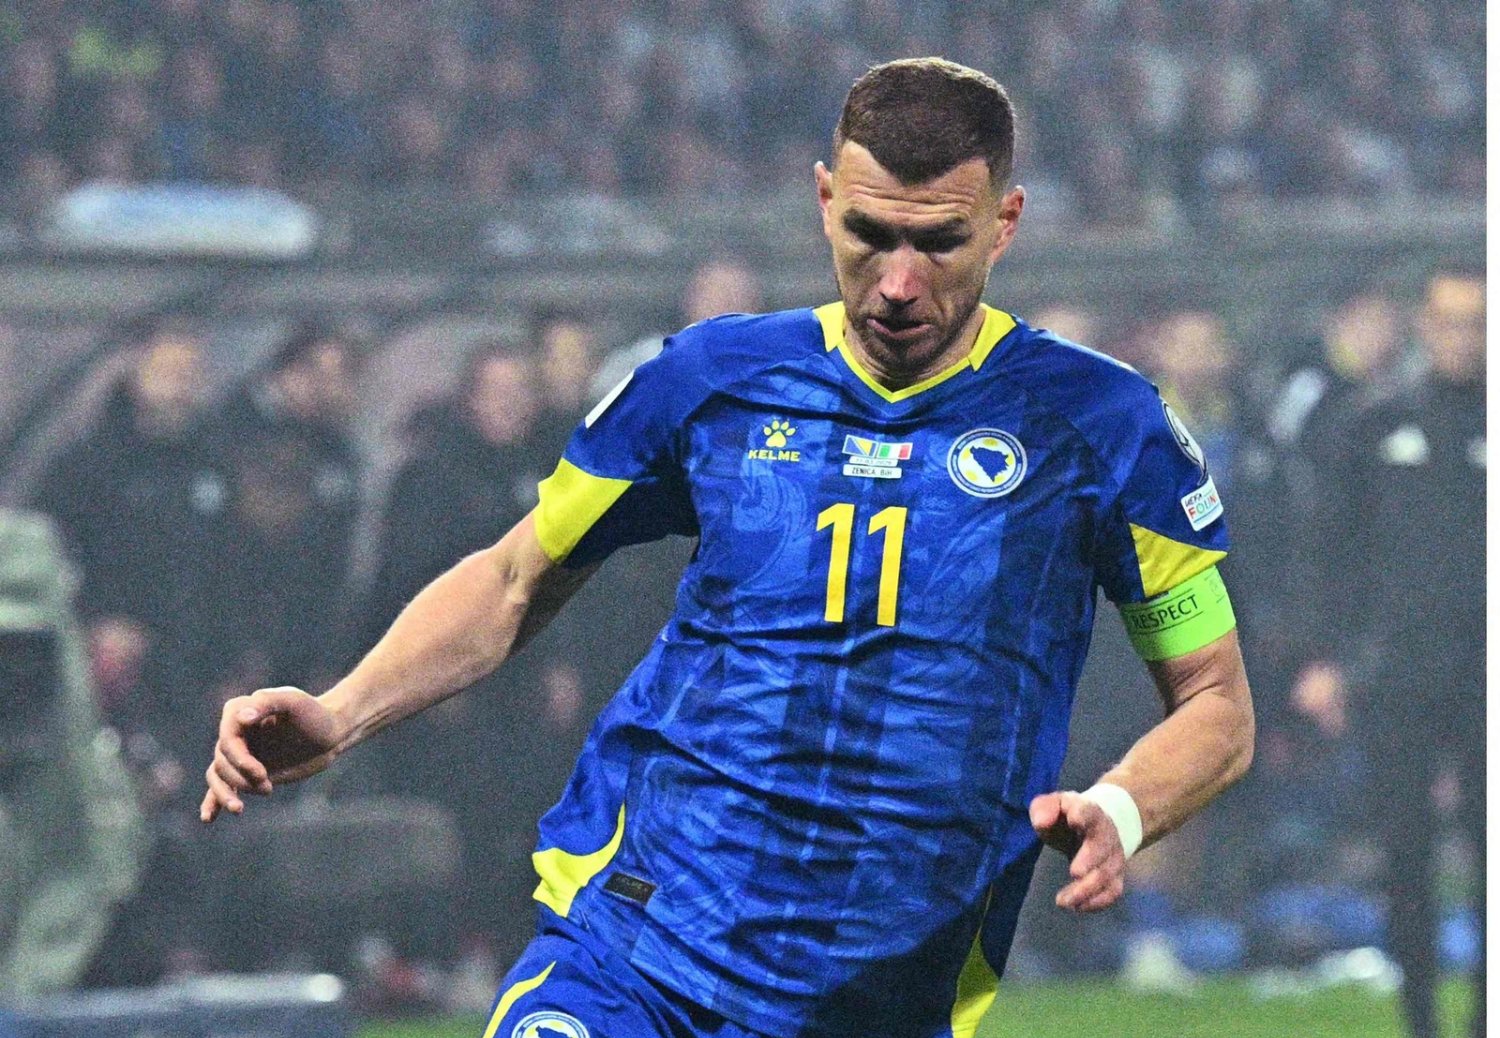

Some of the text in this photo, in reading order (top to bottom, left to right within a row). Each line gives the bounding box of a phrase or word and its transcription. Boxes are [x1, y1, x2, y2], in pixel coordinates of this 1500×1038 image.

[748, 449, 800, 462] KELME
[816, 503, 908, 627] 11
[1130, 594, 1198, 629] RESPECT
